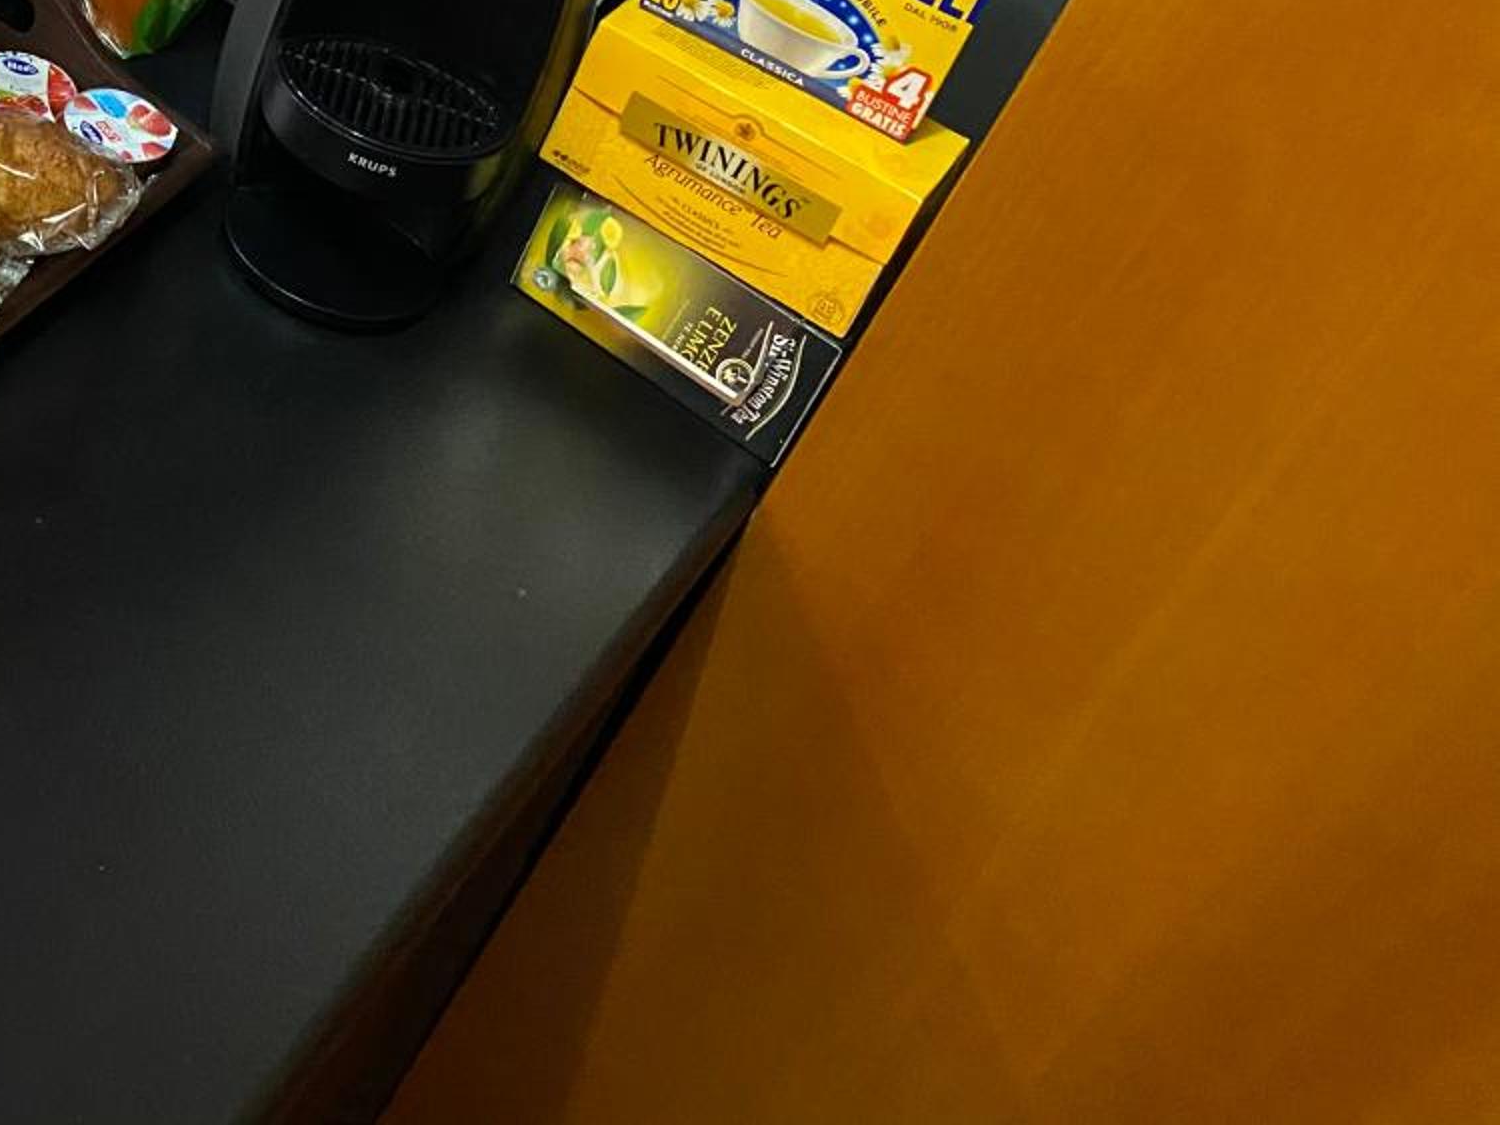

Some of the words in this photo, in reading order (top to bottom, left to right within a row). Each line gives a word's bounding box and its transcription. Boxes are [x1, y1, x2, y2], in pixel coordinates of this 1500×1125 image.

[740, 48, 804, 86] CLASSICA
[856, 89, 911, 124] BUSTINE
[886, 71, 928, 109] 4
[851, 102, 907, 136] GRATIS
[347, 152, 397, 177] KRUPS
[654, 122, 801, 218] TWININGS
[644, 153, 742, 216] Agrumance
[752, 212, 783, 241] Tea
